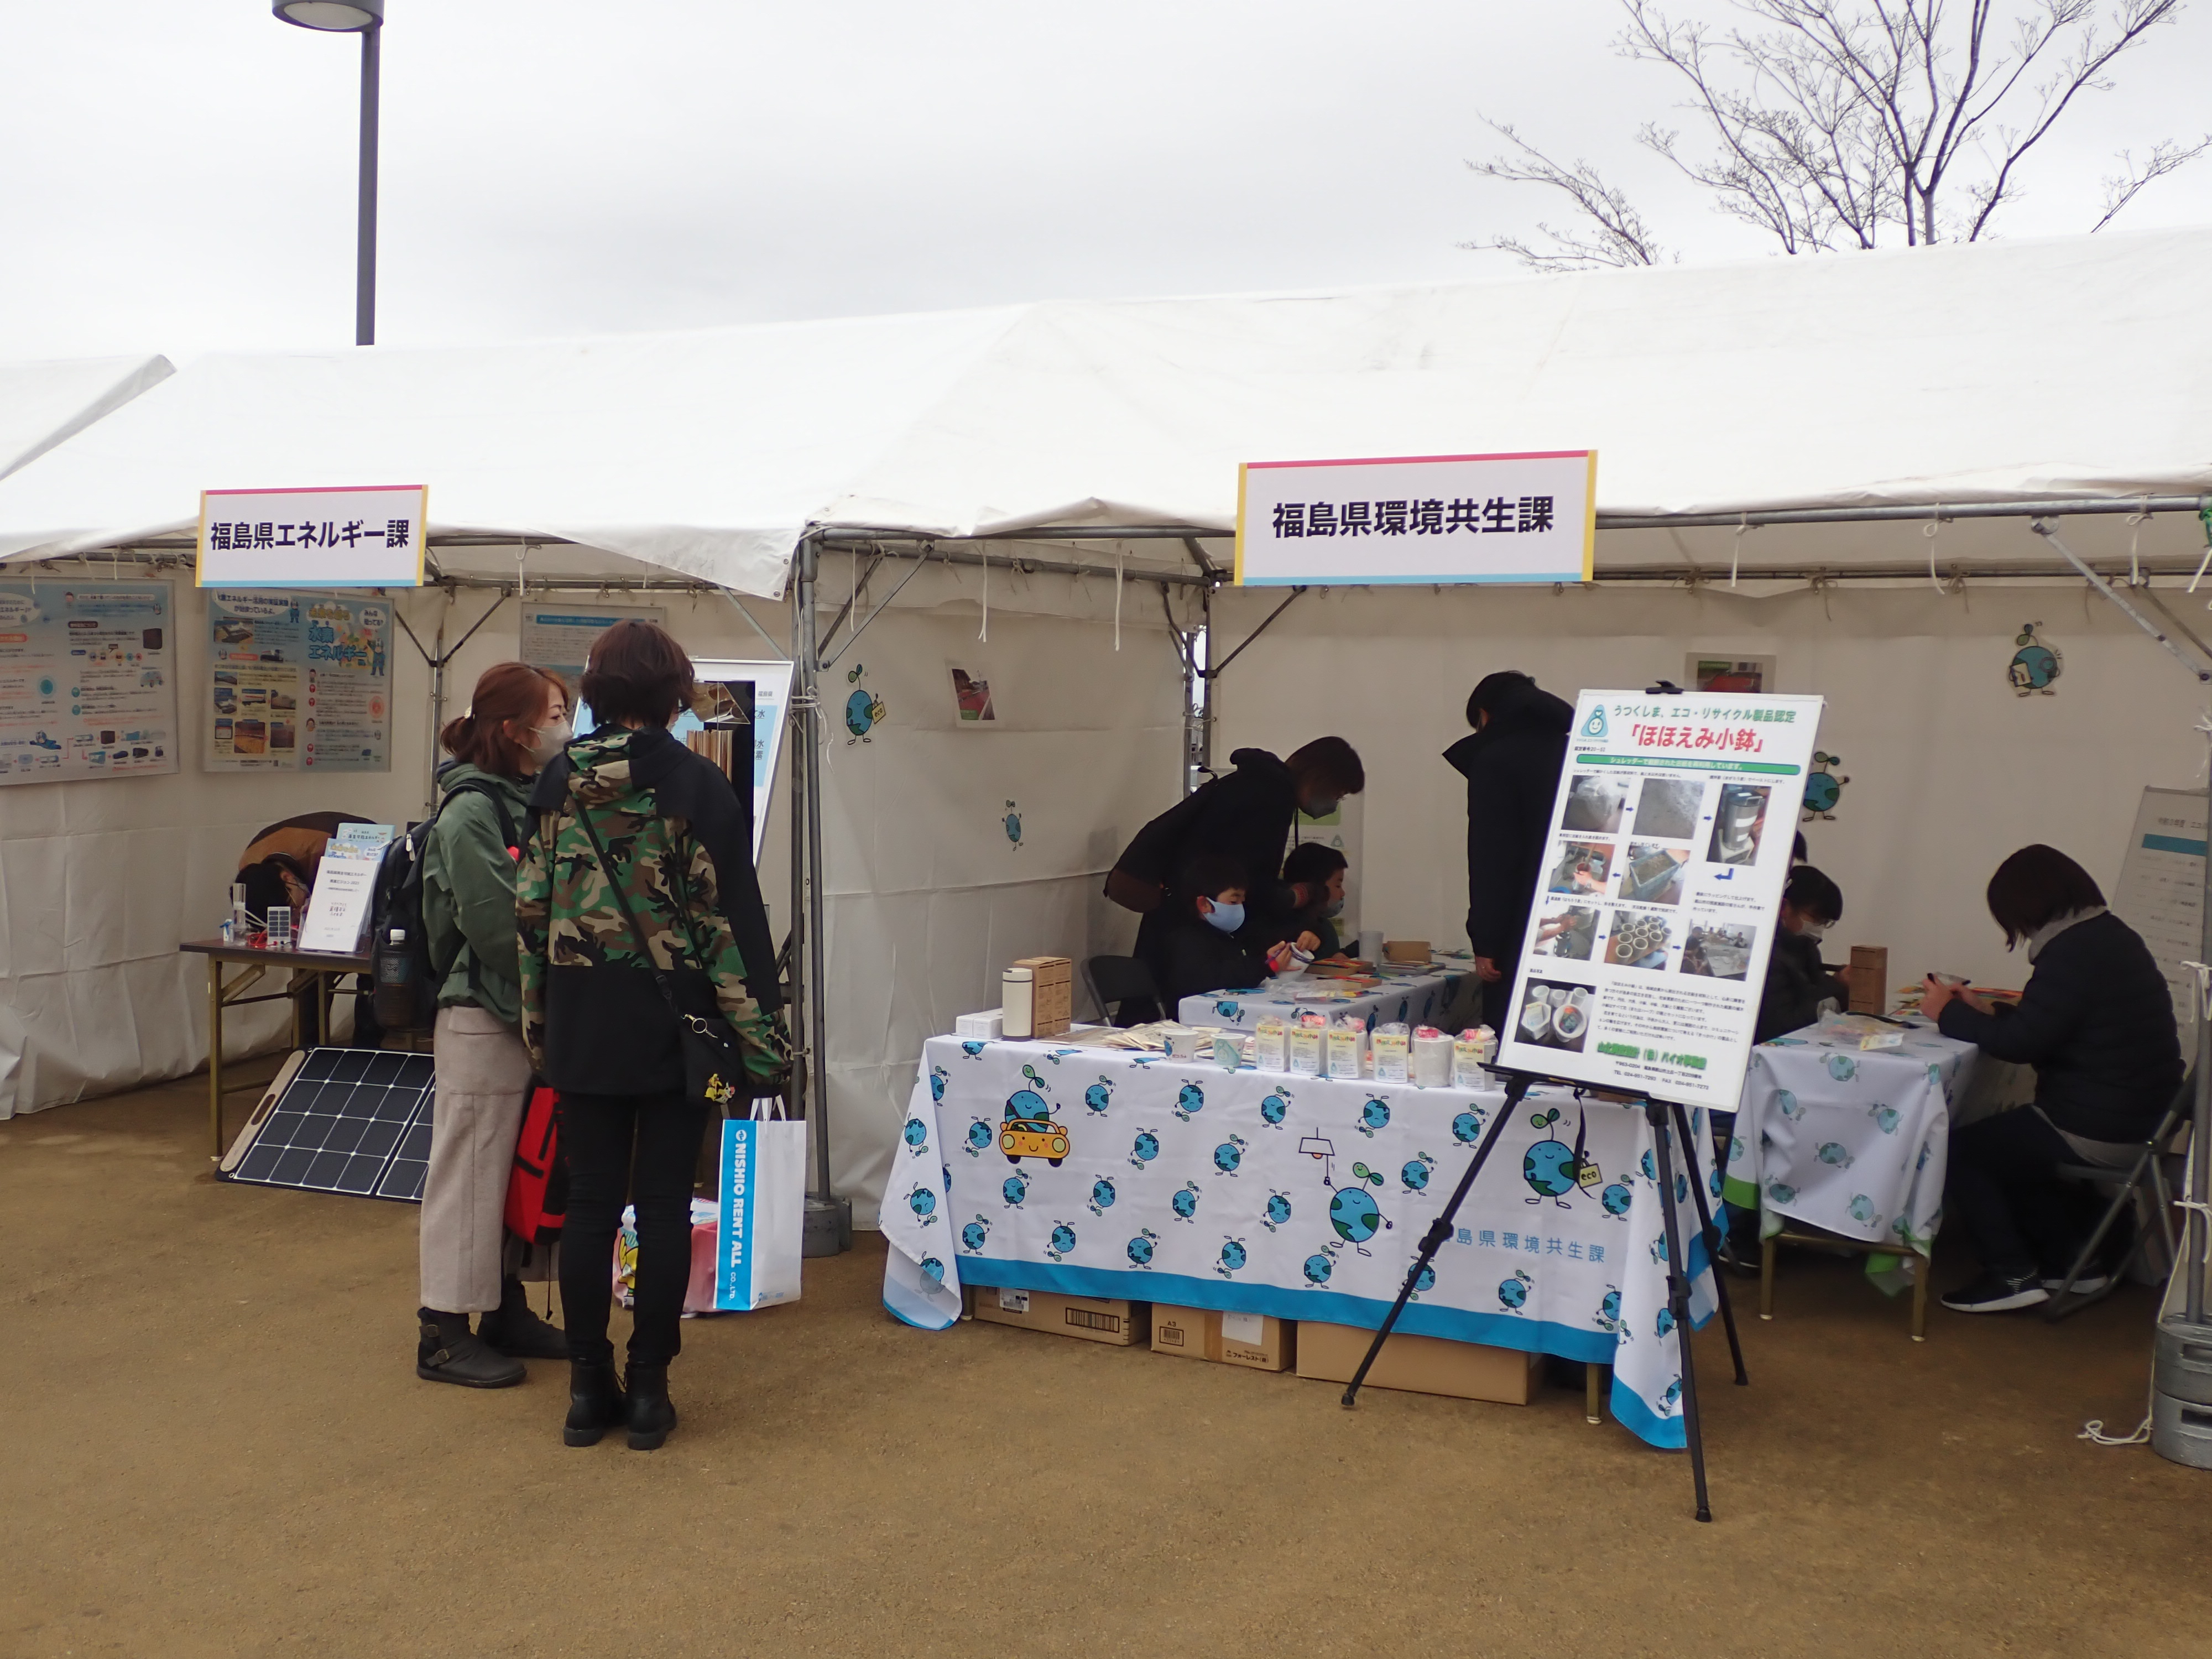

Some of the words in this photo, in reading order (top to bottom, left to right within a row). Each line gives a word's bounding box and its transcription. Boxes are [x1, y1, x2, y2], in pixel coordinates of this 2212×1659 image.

[1272, 496, 1554, 538] 福島県環境共生課
[210, 519, 409, 550] 福島県エネルギー課
[309, 625, 334, 644] 水素
[308, 645, 367, 661] エネルギー
[1614, 705, 1797, 723] うつくしま、エコ・リサイクル製品認定
[1631, 723, 1764, 753] 「ほほえみ小鉢」
[733, 1143, 747, 1196] NISHIO
[1581, 1171, 1597, 1180] eco
[732, 1198, 744, 1238] RENT
[731, 1240, 742, 1268] ALL
[1444, 1228, 1605, 1264] 島県環境共生課
